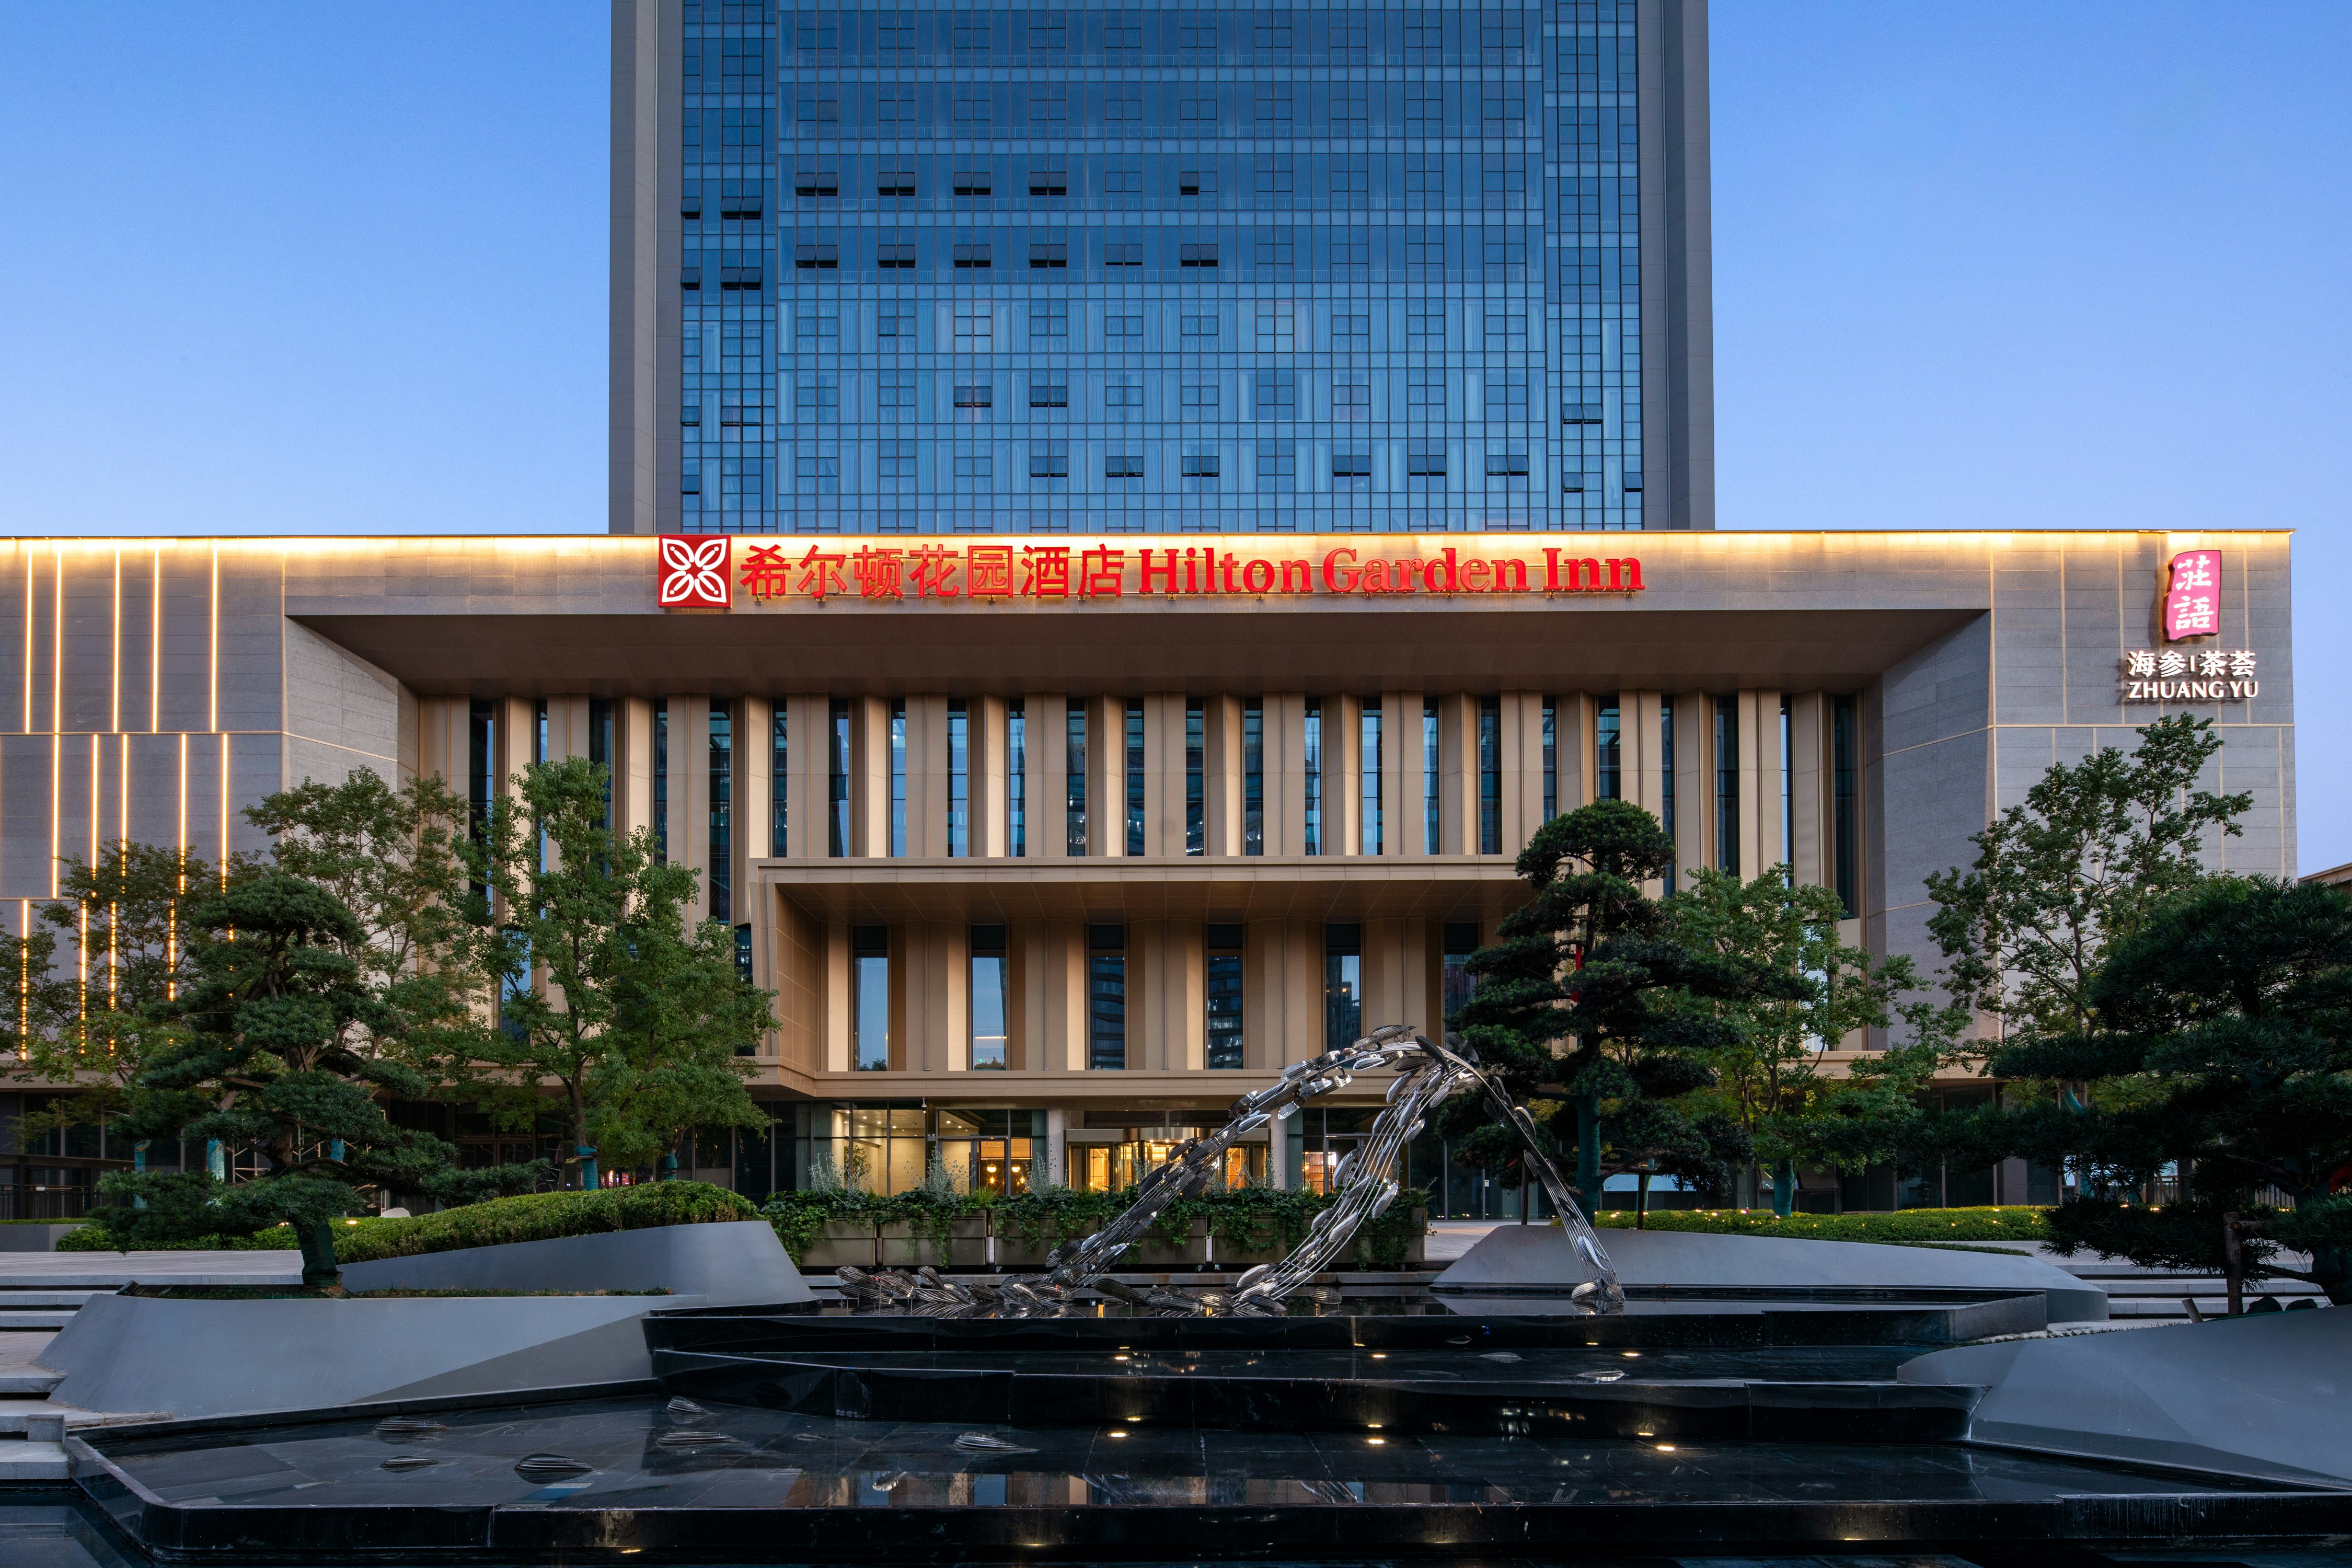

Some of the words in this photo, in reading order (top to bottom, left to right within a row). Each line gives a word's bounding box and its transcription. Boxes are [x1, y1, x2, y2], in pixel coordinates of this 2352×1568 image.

[740, 544, 1125, 599] 希尔顿花园酒店
[1138, 547, 1313, 594] Hilton
[1321, 547, 1531, 594] Garden
[1541, 547, 1646, 591] Inn
